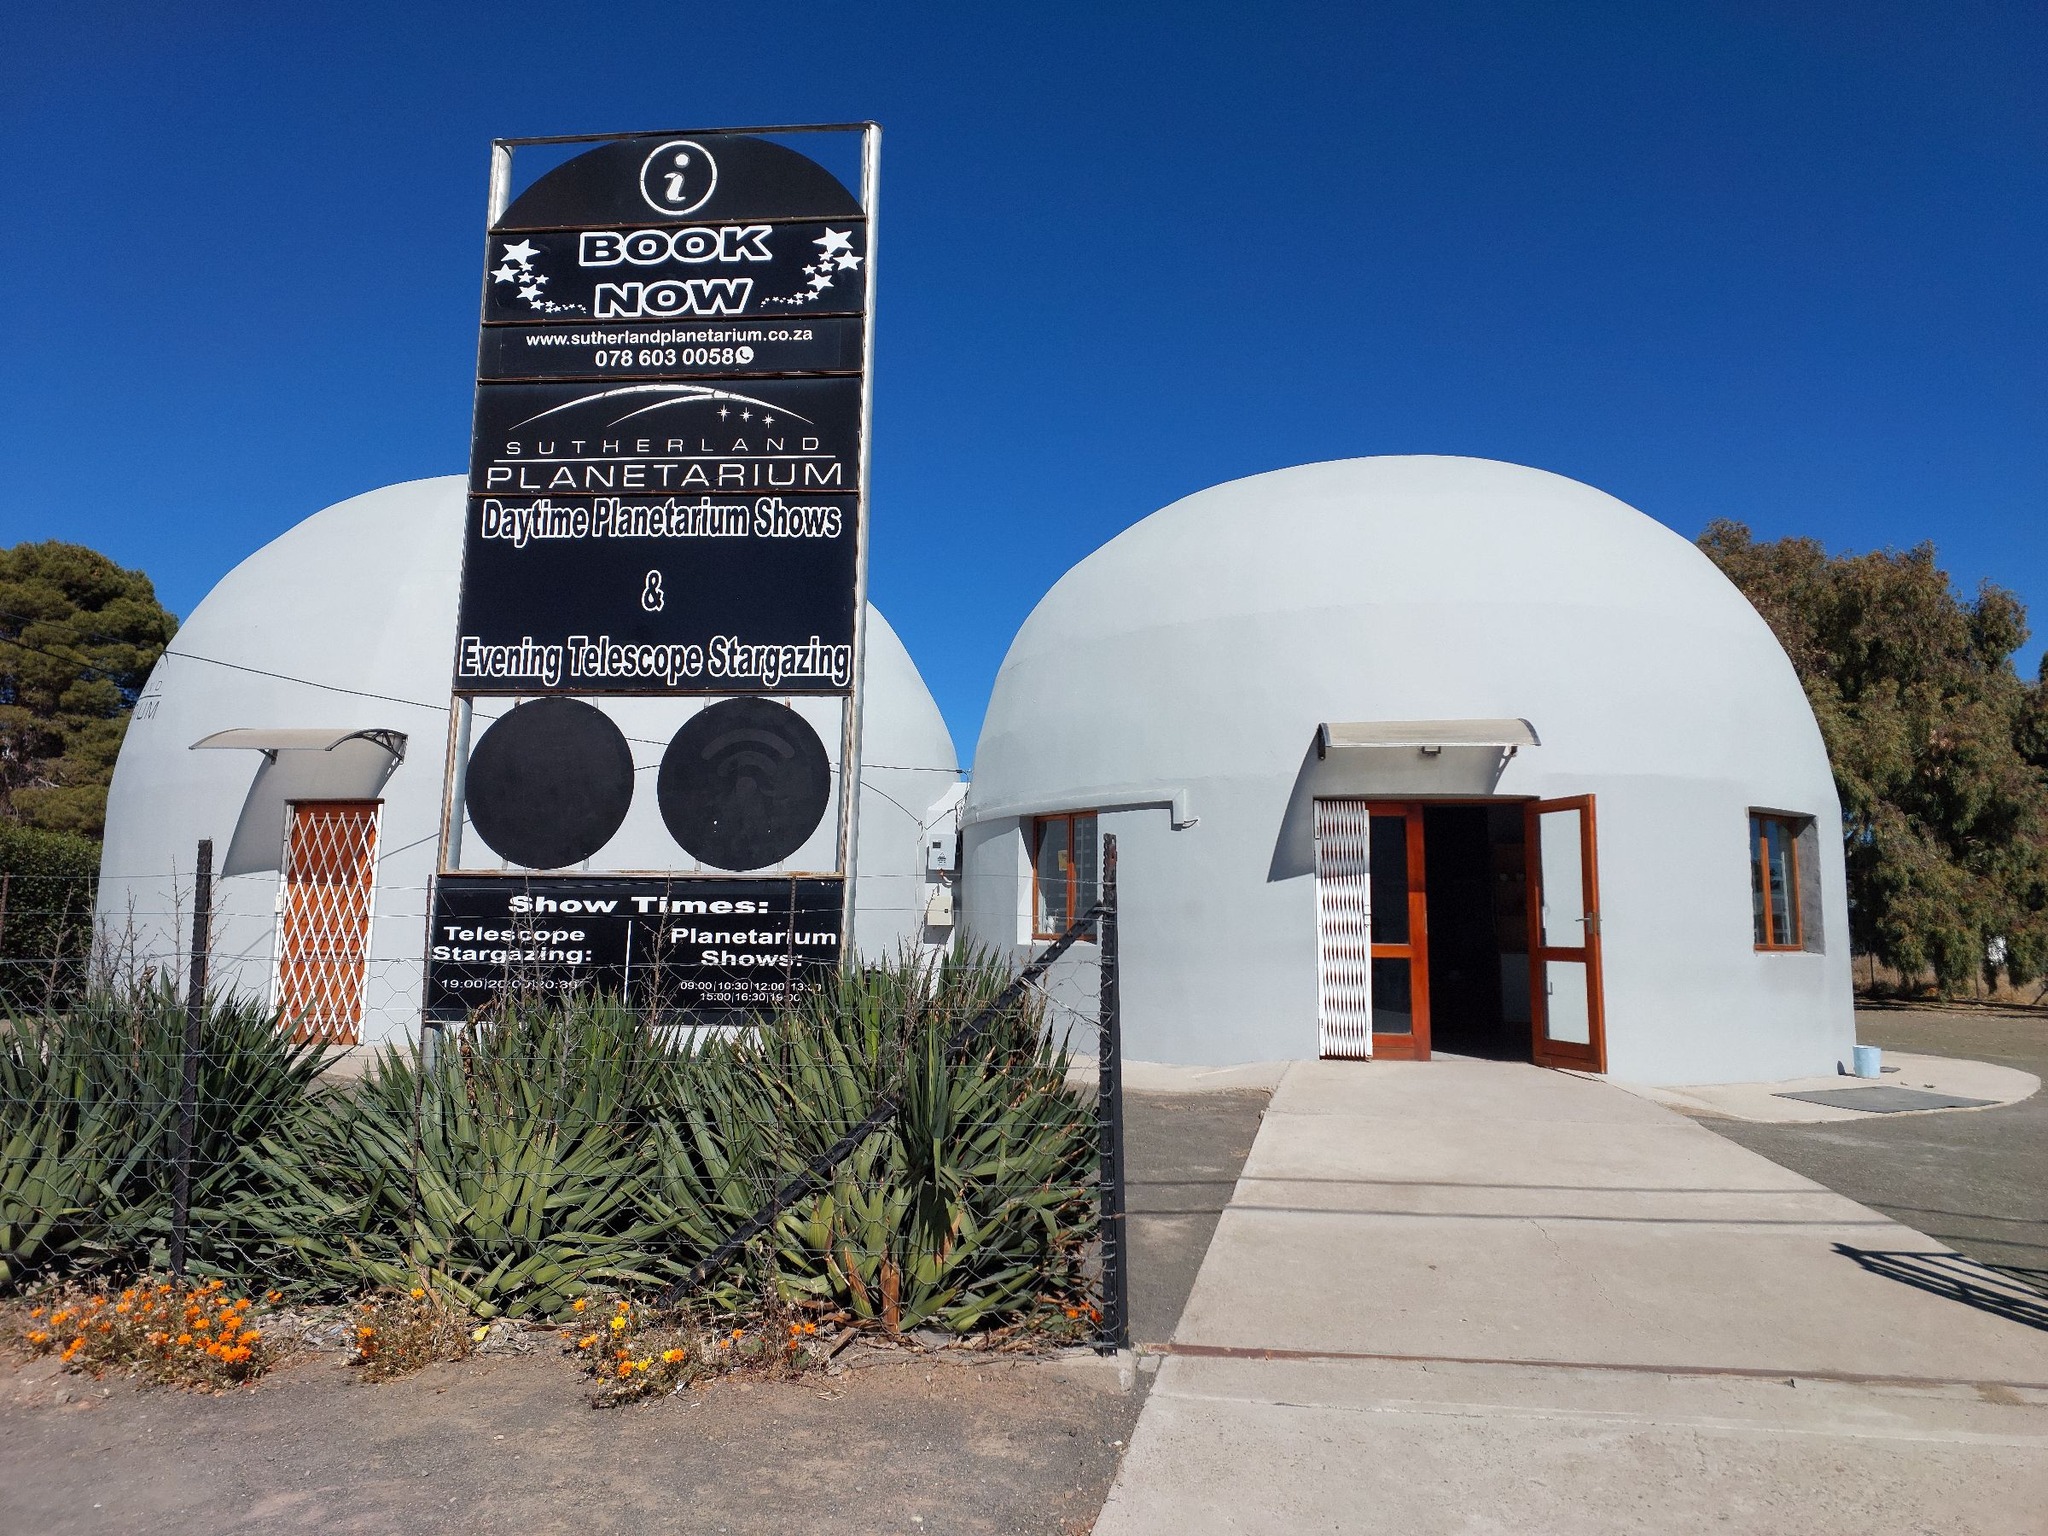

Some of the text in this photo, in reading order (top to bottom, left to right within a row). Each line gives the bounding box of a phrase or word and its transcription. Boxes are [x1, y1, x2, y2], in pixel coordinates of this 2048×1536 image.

[578, 225, 773, 267] BOOK
[593, 278, 754, 318] NOW
[525, 328, 813, 347] www.sutherlandplanetarium.co.za
[595, 348, 734, 367] 078 603 0058
[505, 436, 820, 455] SUTHERLAND
[486, 462, 842, 490] PLANETARIUM
[481, 497, 842, 548] Daytime Planetarium Shows
[641, 569, 665, 612] &
[458, 635, 852, 687] Evening Telescope Stargazing
[508, 895, 769, 914] Show Times:
[443, 926, 586, 945] Telescope
[671, 927, 837, 946] Planetarium
[432, 946, 593, 965] Stargazing:
[701, 950, 803, 968] Shows:
